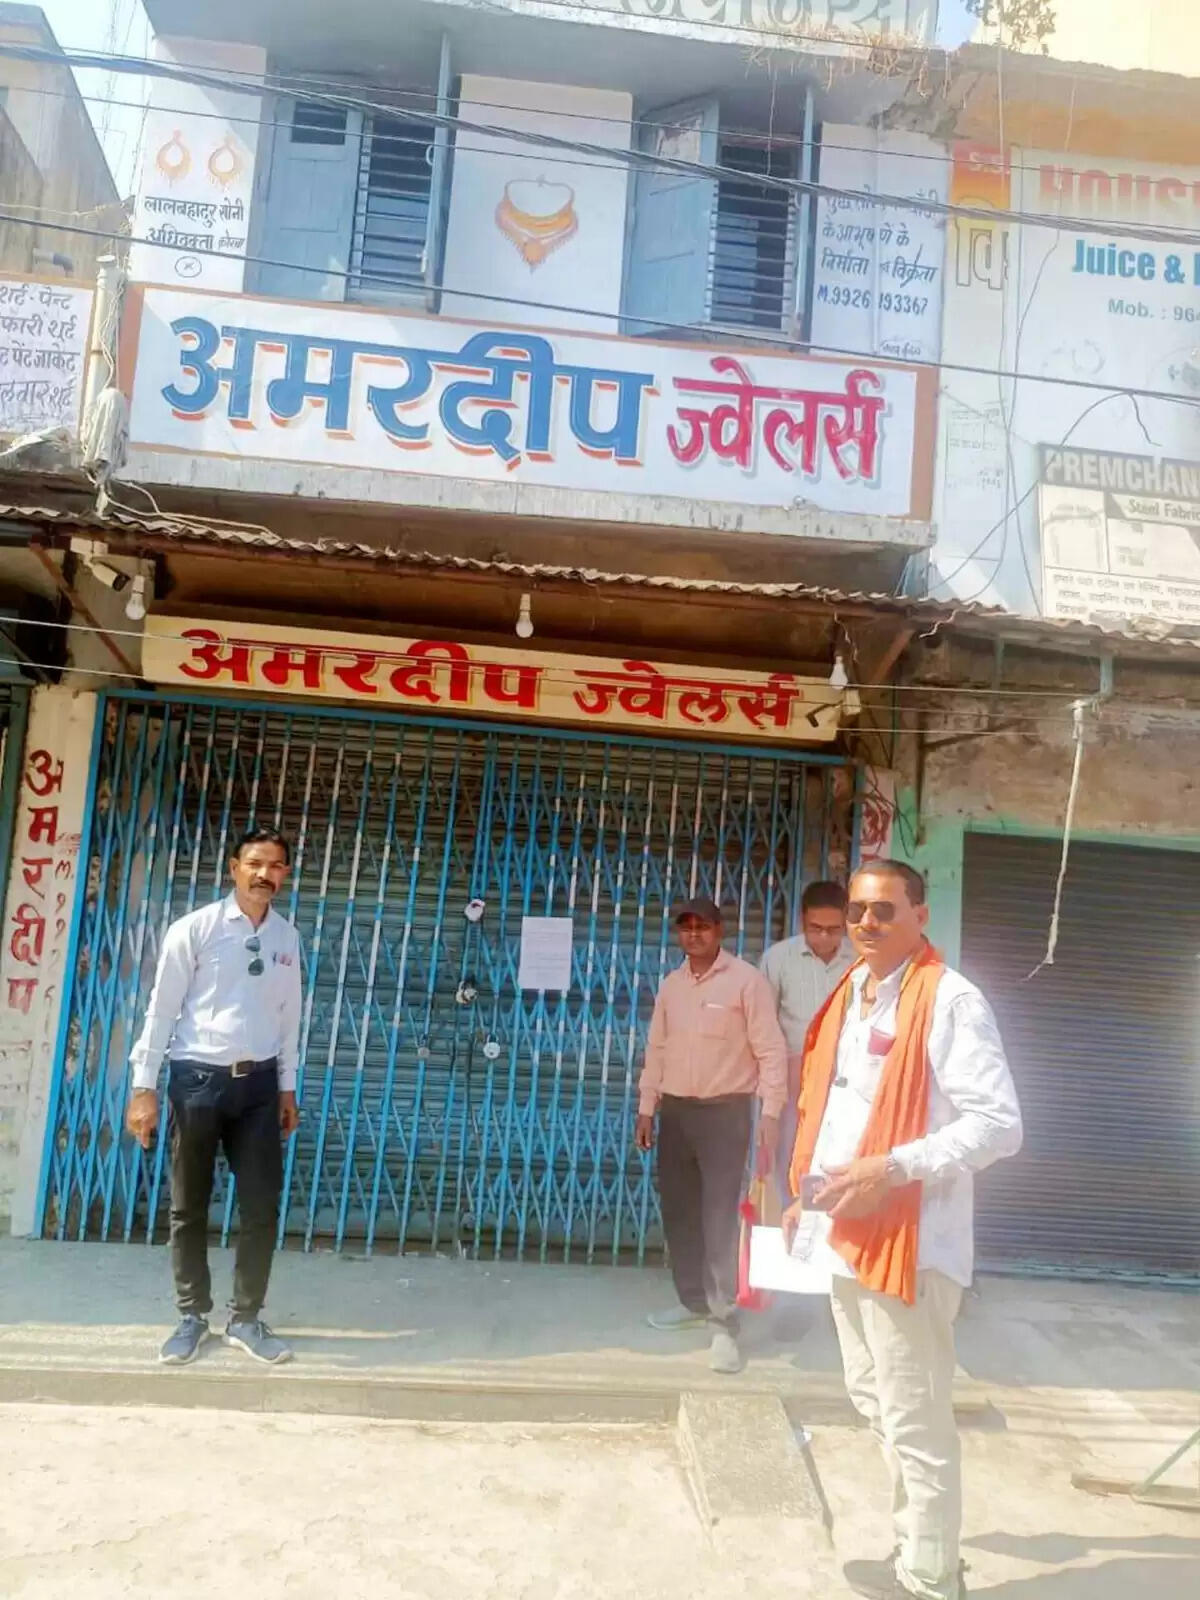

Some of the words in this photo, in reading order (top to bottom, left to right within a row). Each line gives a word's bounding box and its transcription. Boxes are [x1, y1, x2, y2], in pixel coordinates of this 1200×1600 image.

[219, 197, 244, 221] सोनी
[896, 222, 911, 247] के
[821, 247, 870, 276] निर्माता
[1072, 239, 1156, 281] Juice
[1163, 254, 1186, 285] &
[1108, 298, 1155, 319] Mob.
[0, 313, 43, 337] फारी
[161, 316, 657, 468] अमरदीप
[667, 356, 888, 481] ज्वेलर्स
[178, 628, 543, 708] अमरदीप
[573, 660, 800, 729] ज्वेलर्स
[7, 749, 64, 1015] अमरदीप
